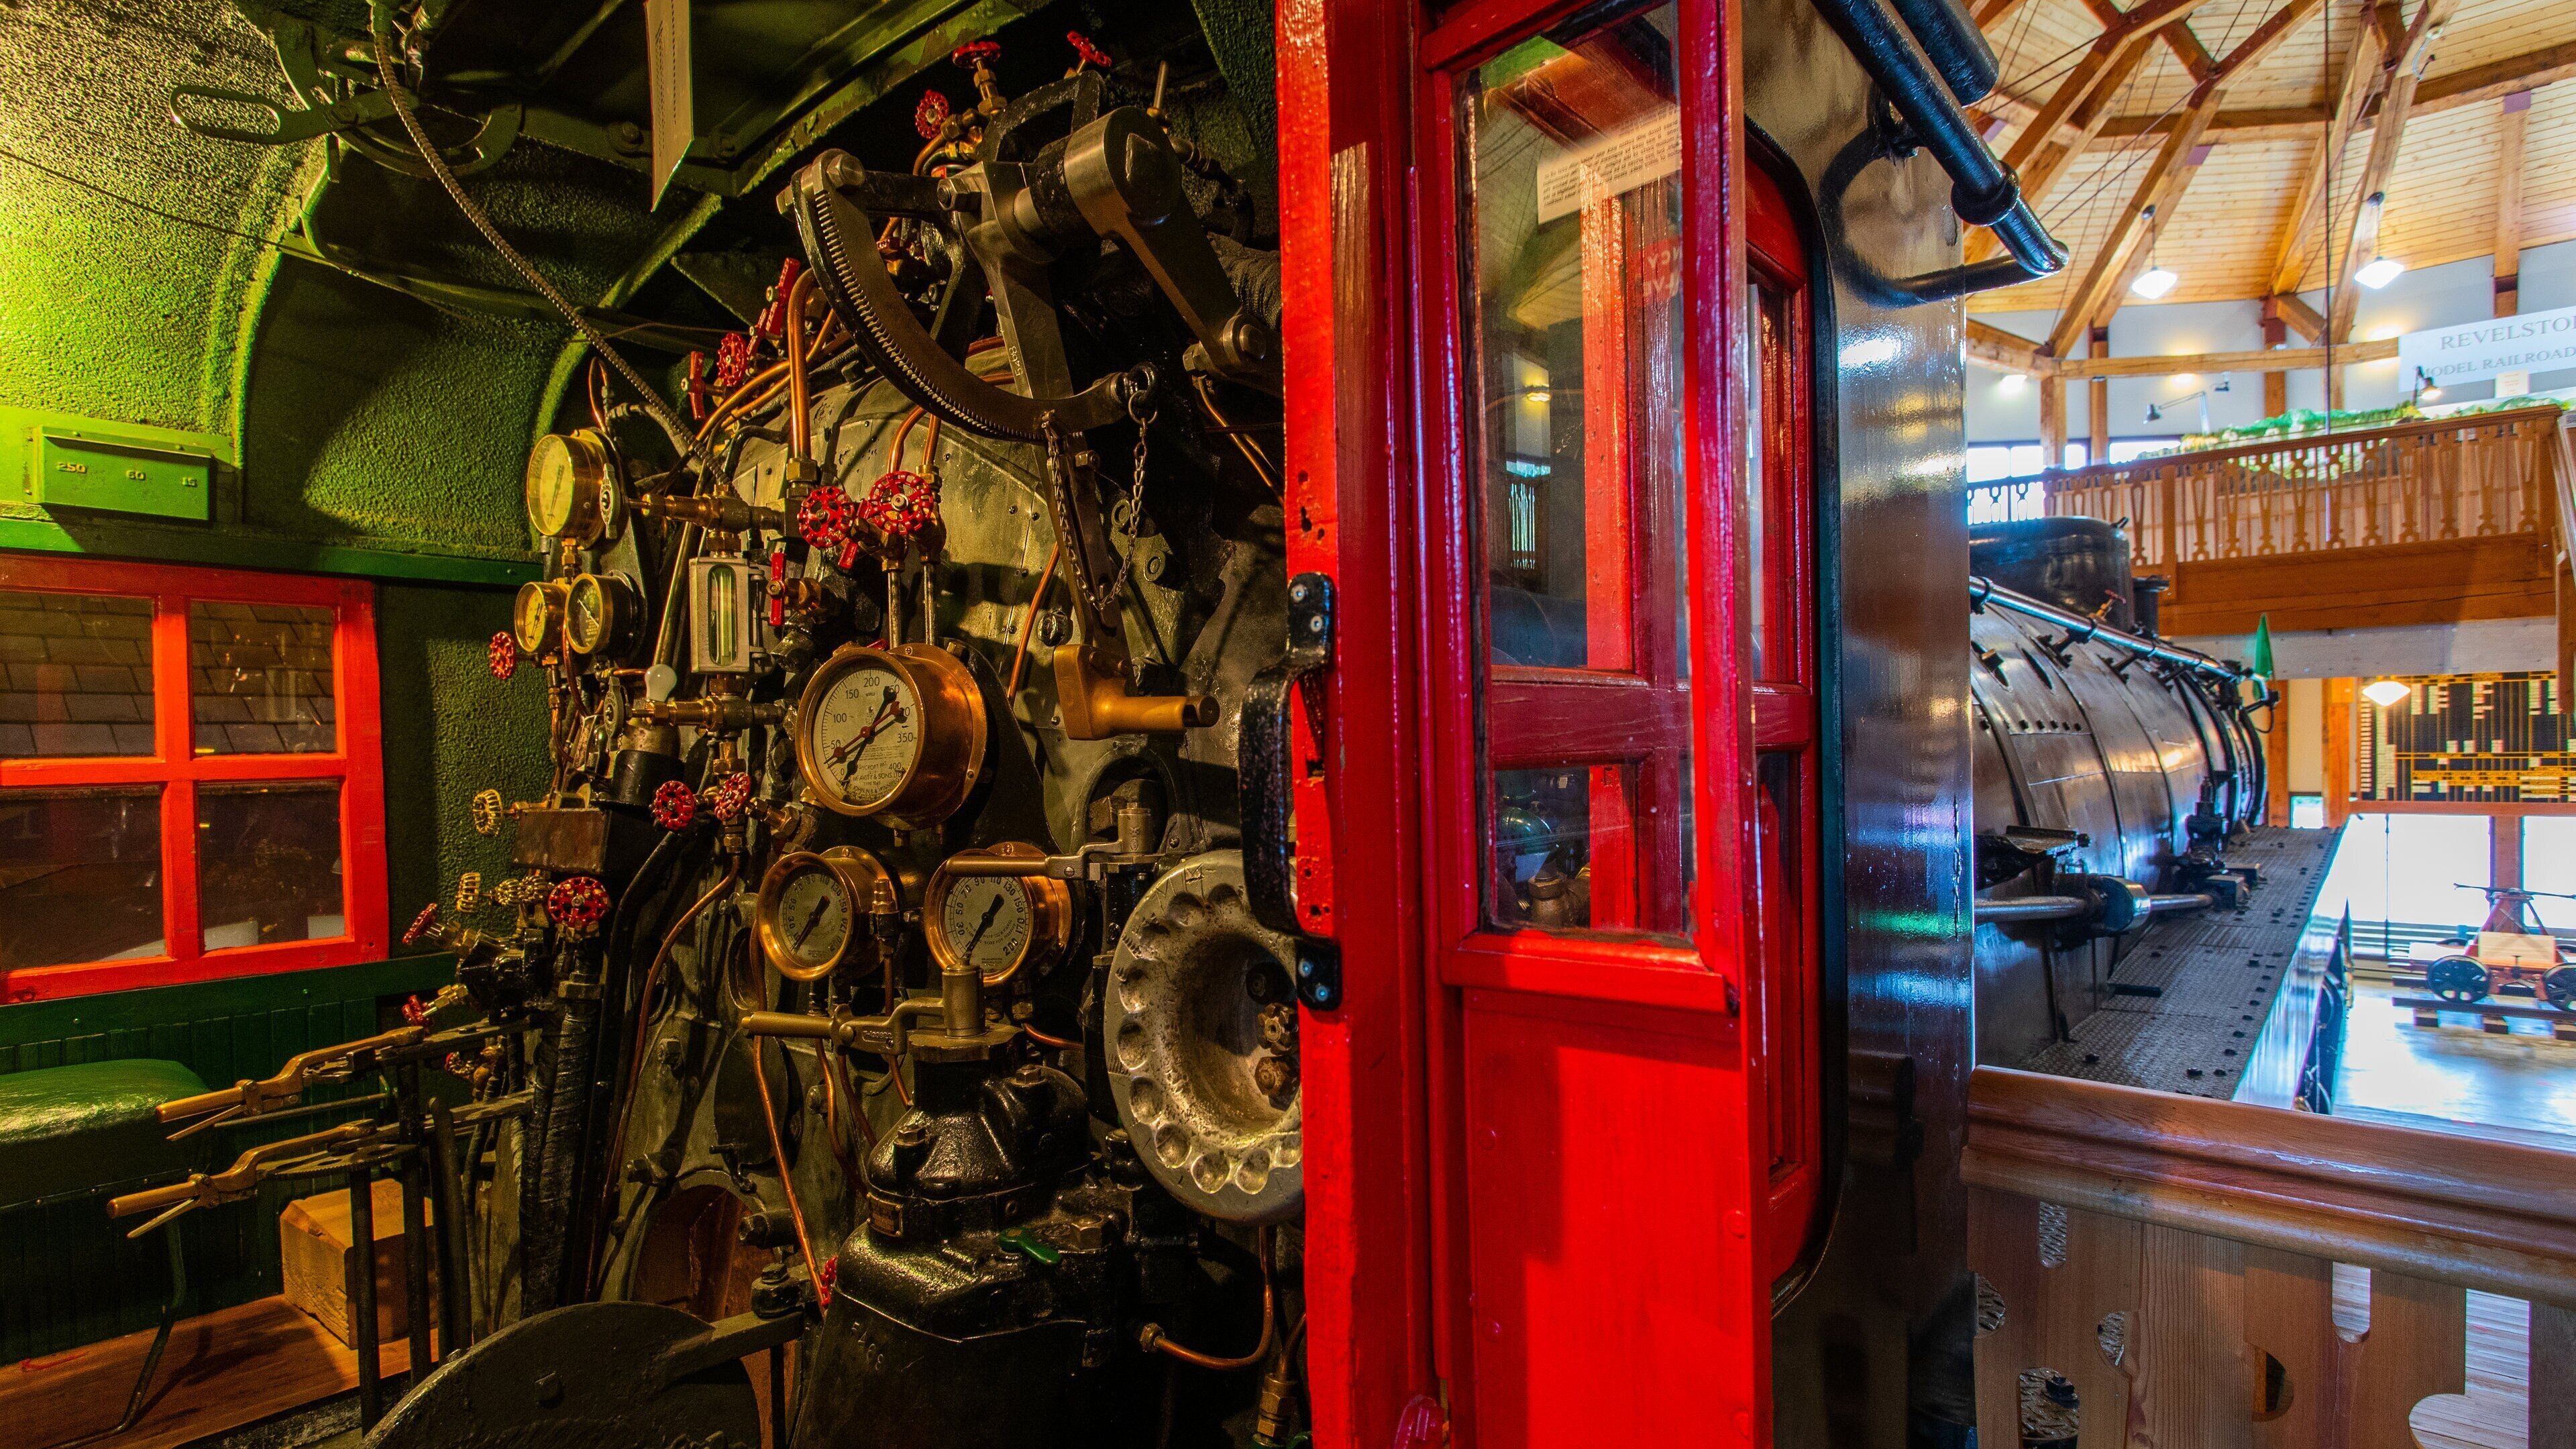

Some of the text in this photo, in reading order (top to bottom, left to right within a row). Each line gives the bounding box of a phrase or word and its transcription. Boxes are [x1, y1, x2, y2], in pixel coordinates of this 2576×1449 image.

[2482, 346, 2576, 370] RAILROAD
[56, 461, 199, 488] 250 60 15
[863, 676, 880, 688] 200
[845, 688, 859, 699] 150
[833, 712, 847, 723] 100
[830, 739, 841, 750] 50
[897, 732, 914, 743] 350
[840, 767, 845, 775] 0
[889, 761, 902, 770] 400
[961, 884, 972, 899] 70
[1003, 880, 1016, 896] 130
[788, 898, 797, 911] 50
[838, 898, 849, 914] 150
[955, 902, 964, 916] 50
[1014, 897, 1024, 914] 150
[788, 916, 796, 930] 30
[956, 922, 965, 936] 30
[1015, 917, 1025, 934] 170
[1002, 937, 1019, 957] 200
